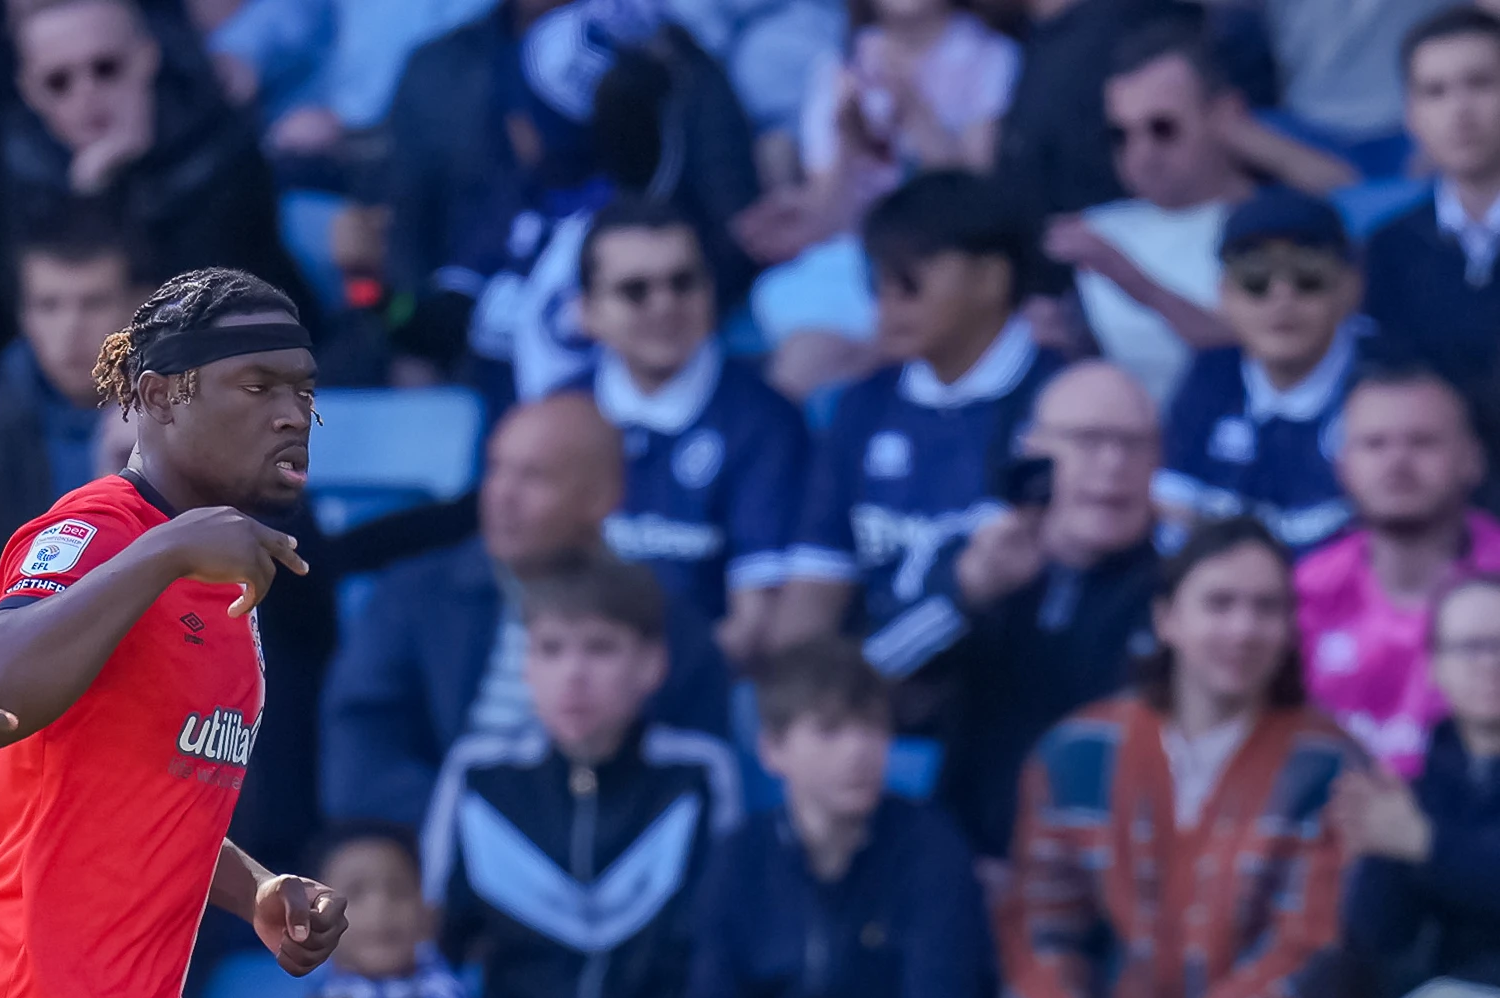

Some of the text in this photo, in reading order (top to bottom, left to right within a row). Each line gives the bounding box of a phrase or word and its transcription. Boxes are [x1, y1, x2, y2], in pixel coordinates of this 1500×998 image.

[62, 524, 87, 537] bet
[31, 562, 49, 571] EFL
[6, 579, 67, 595] GETHER
